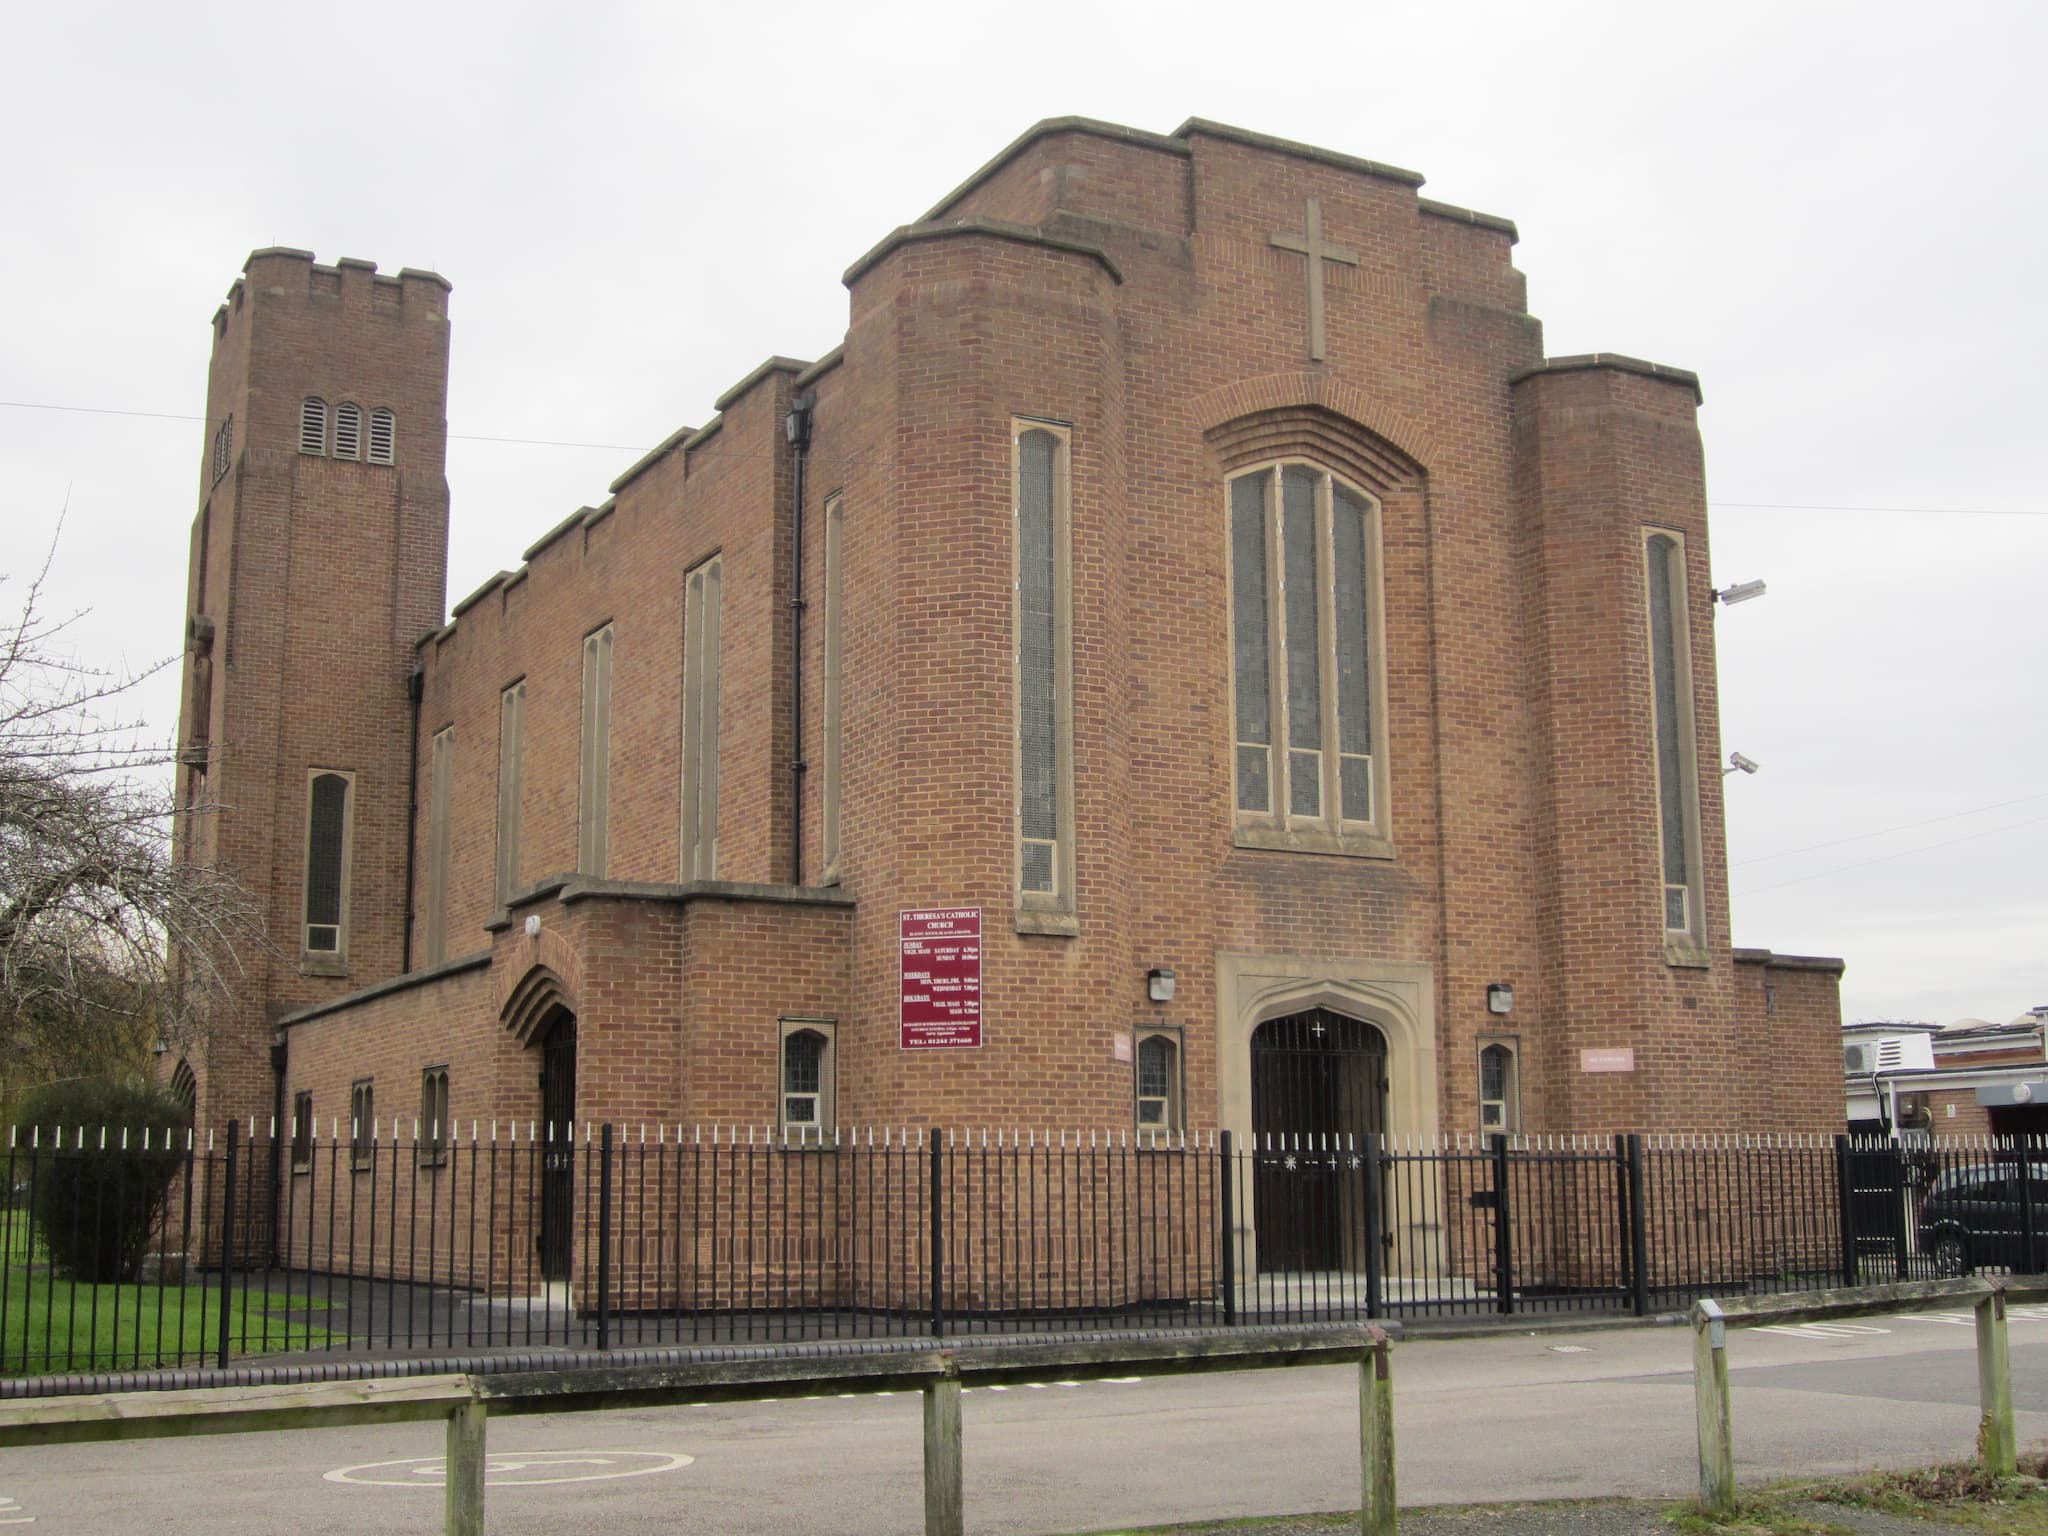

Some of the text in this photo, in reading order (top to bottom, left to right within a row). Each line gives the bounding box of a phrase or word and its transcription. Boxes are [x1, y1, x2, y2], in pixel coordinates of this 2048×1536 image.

[913, 912, 945, 920] THERESA'S
[946, 911, 978, 919] CATHOLIC
[927, 921, 953, 929] CHURCH
